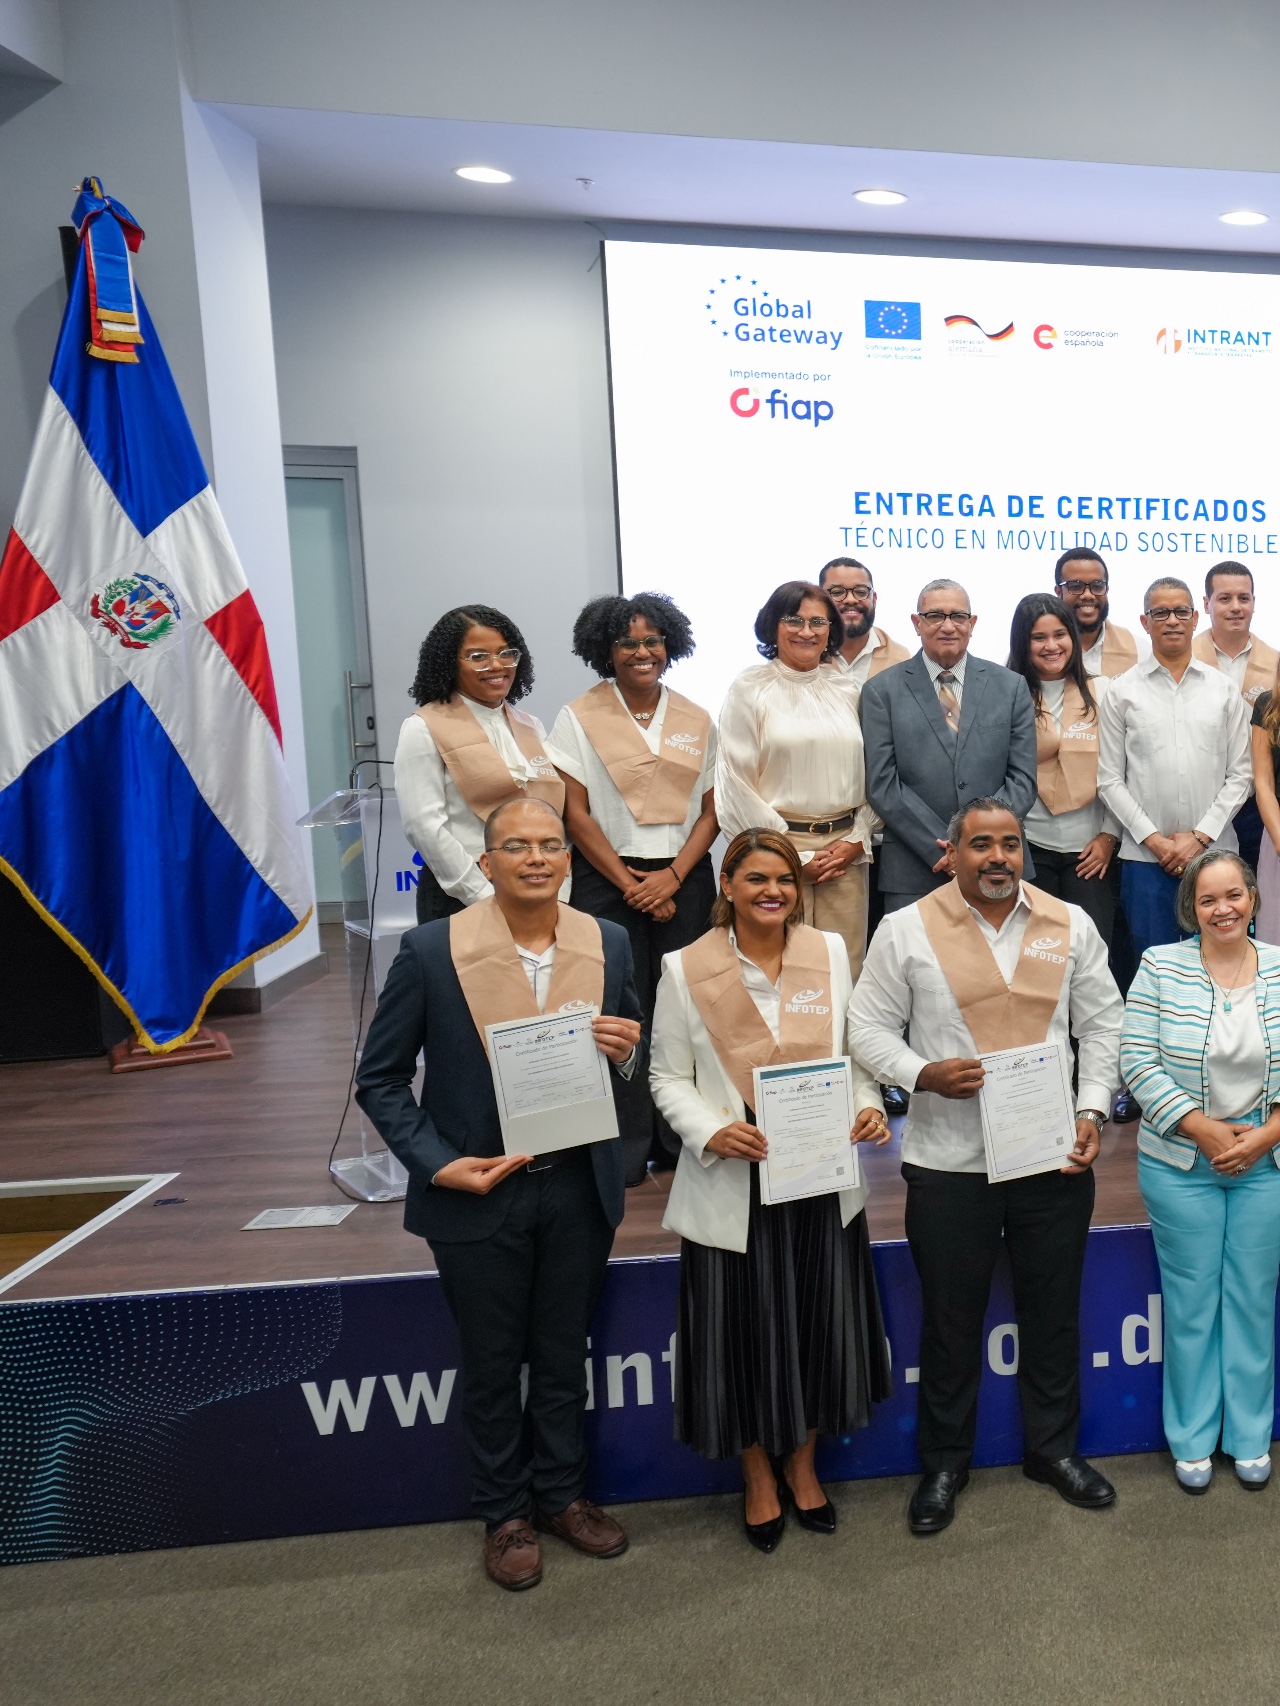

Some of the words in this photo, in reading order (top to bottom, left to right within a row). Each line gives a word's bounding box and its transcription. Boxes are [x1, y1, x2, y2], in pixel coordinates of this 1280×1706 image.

[733, 297, 812, 319] Global
[734, 322, 843, 351] Gateway
[1063, 330, 1119, 338] cooperación
[1064, 339, 1104, 347] española
[1187, 328, 1272, 346] INTRANT
[729, 368, 810, 381] Implementado
[813, 372, 831, 382] por
[766, 389, 834, 427] fiap
[853, 491, 996, 518] ENTREGA
[1007, 495, 1045, 519] DE
[1057, 496, 1267, 522] CERTIFICADOS
[839, 521, 945, 549] TÉCNICO
[956, 529, 985, 550] EN
[997, 529, 1129, 552] MOVILIDAD
[1137, 531, 1279, 554] SOSTENIBLE
[1063, 731, 1097, 741] INFOTEP
[664, 737, 702, 756] INFOTEP
[1024, 946, 1066, 965] INFOTEP
[785, 1003, 829, 1015] INFOTEP
